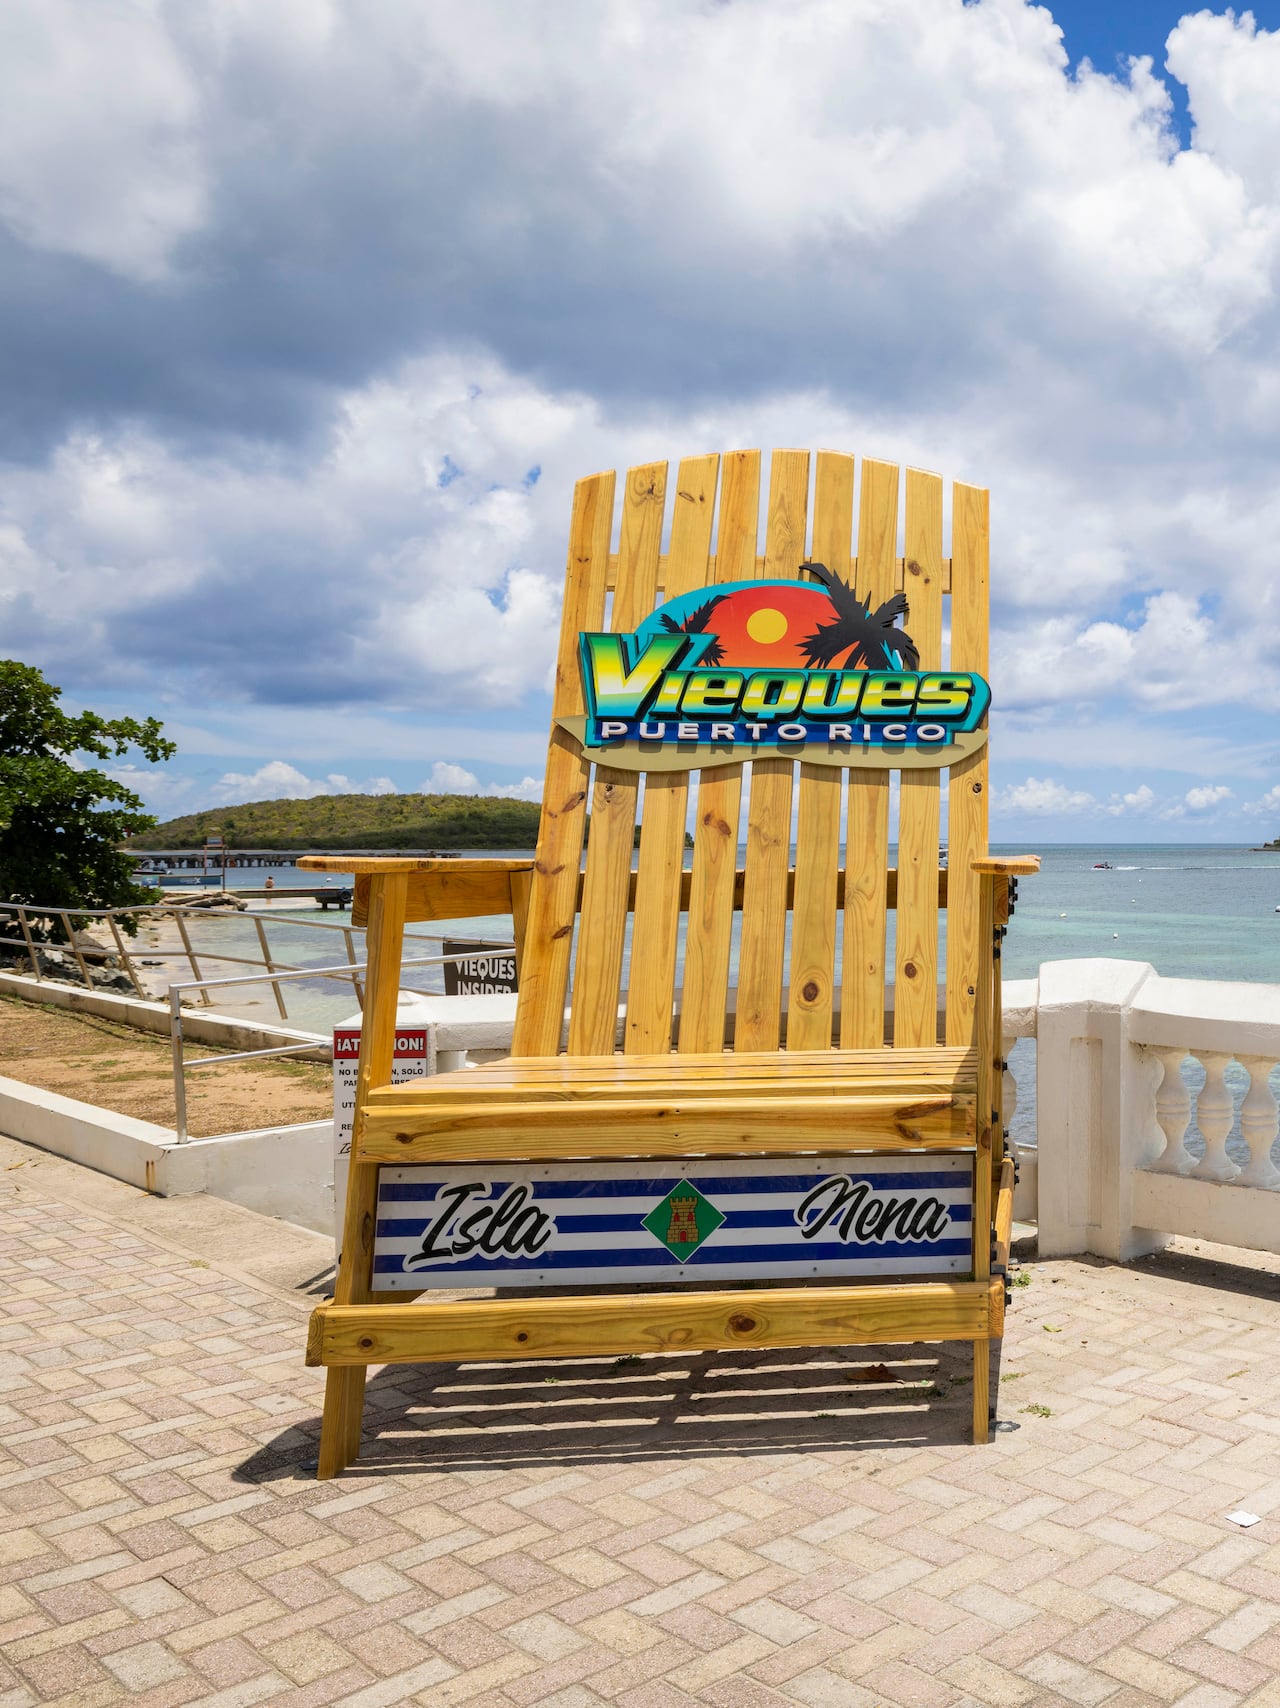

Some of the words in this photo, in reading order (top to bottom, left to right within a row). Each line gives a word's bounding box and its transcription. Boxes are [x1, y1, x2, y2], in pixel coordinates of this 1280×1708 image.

[600, 721, 808, 741] PUERTO
[829, 723, 946, 742] RICO
[456, 959, 515, 980] VIEQUES
[337, 1038, 424, 1051] ¡ATION!
[408, 1181, 552, 1264] Isla
[798, 1175, 948, 1242] Nena
